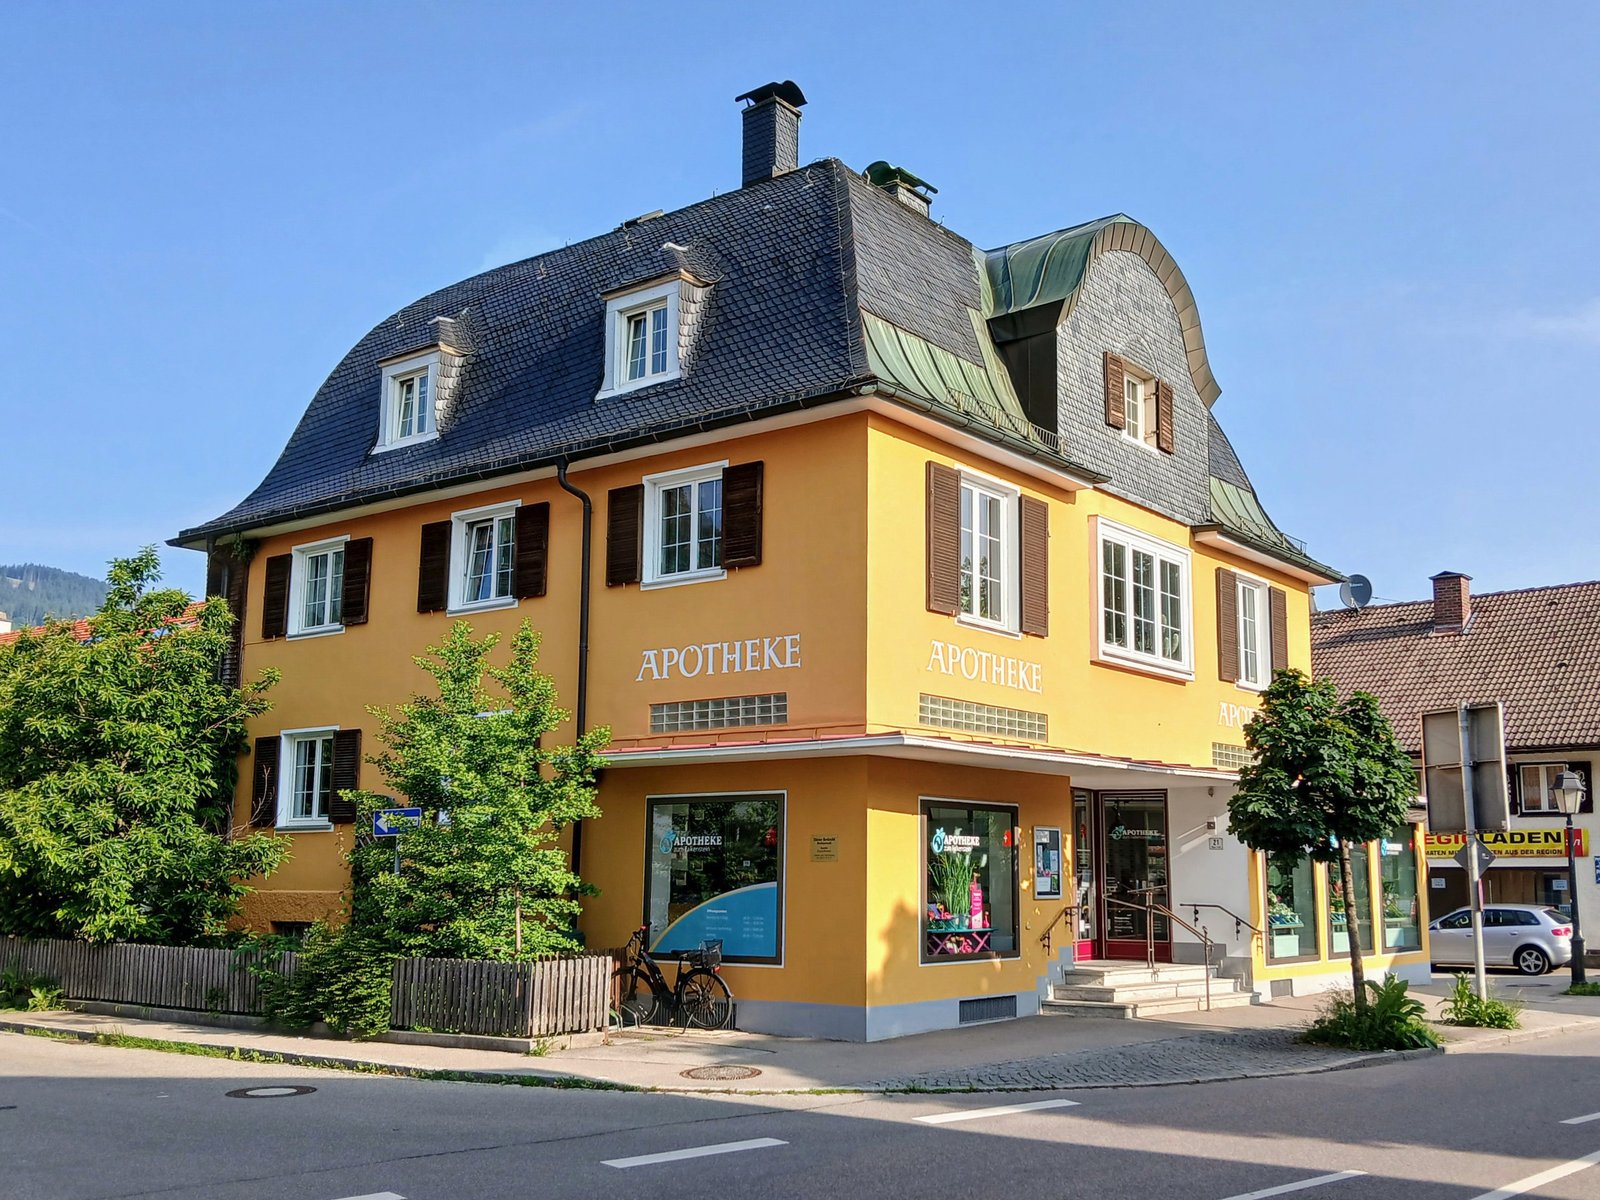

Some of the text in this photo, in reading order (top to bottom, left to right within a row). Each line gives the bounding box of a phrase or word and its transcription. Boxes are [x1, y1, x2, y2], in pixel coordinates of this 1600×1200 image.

[635, 633, 801, 682] APOTHEKE
[926, 639, 1043, 695] APOTHEKE
[1217, 700, 1259, 731] APOT
[673, 835, 723, 846] APOTHEKE
[943, 834, 980, 847] APOTHEKE
[1424, 831, 1562, 845] EGILADEN
